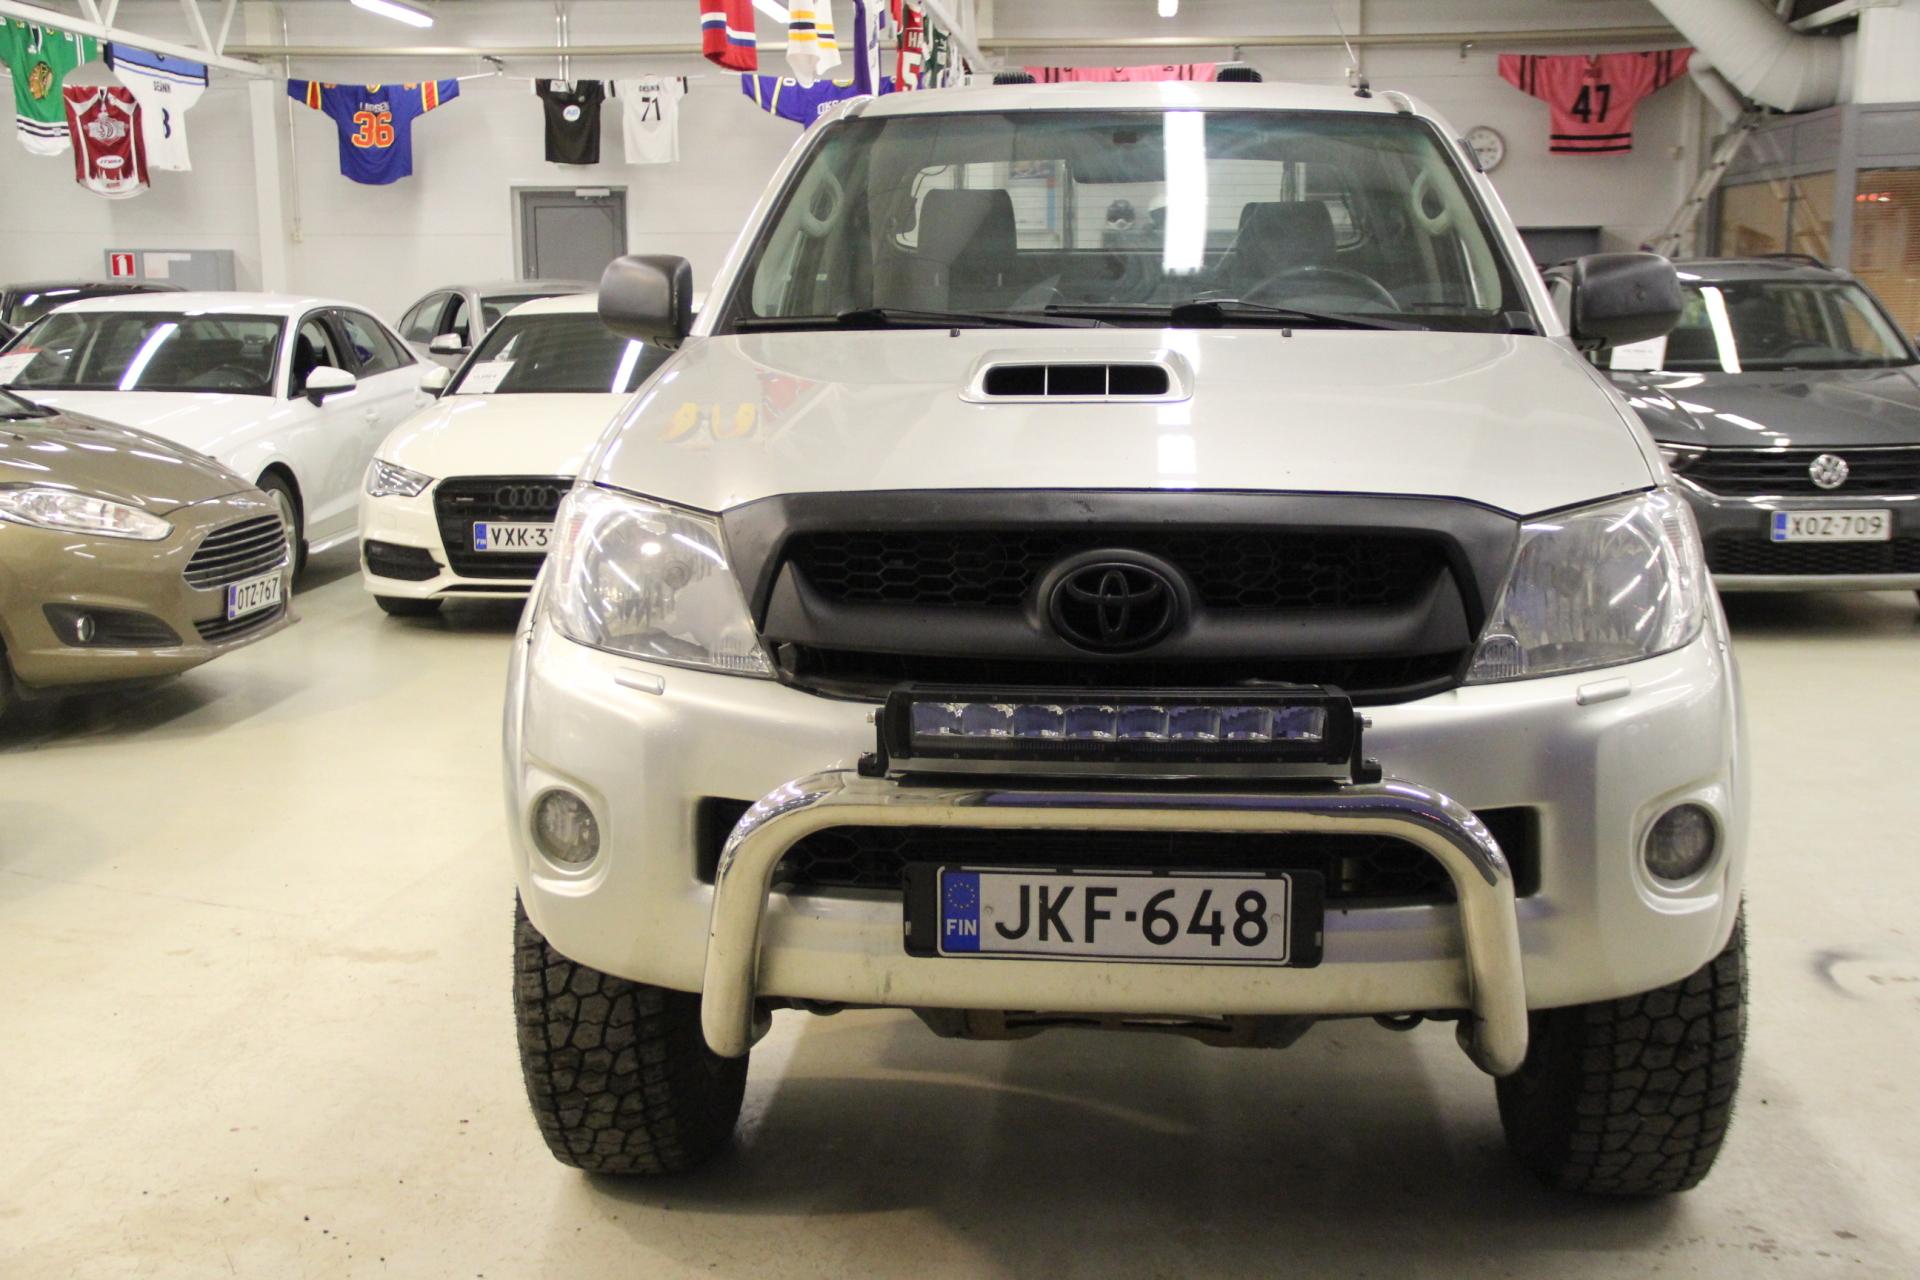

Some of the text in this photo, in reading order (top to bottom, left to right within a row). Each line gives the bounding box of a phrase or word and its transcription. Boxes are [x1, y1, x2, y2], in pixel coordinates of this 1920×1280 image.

[641, 96, 661, 122] 71
[1571, 84, 1610, 123] 47
[351, 111, 394, 148] 36
[491, 528, 553, 546] VXK-3
[1791, 516, 1883, 535] XOZ-709
[238, 577, 279, 610] OTZ-767
[946, 918, 977, 936] FIN
[995, 884, 1268, 947] JKF-648
